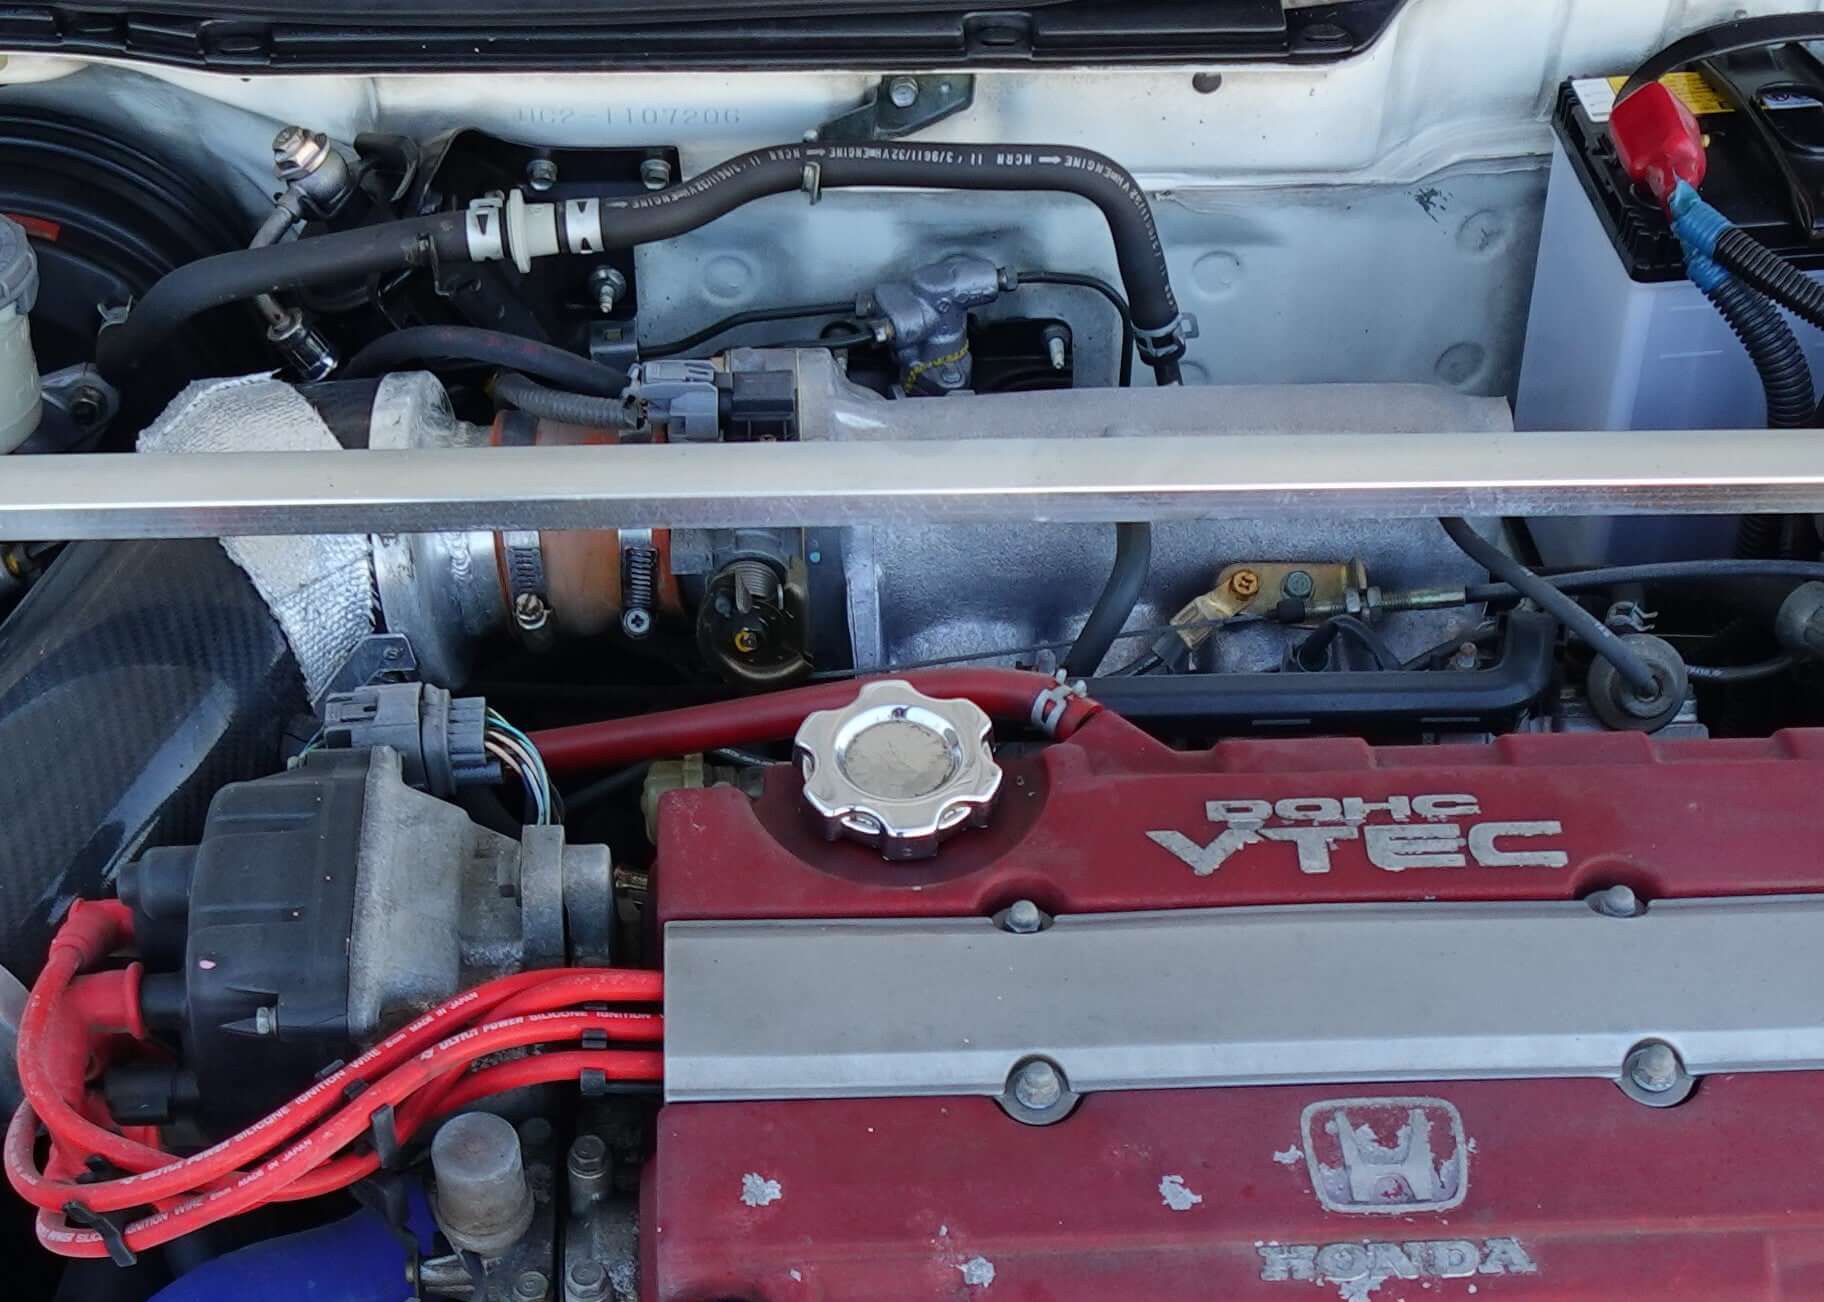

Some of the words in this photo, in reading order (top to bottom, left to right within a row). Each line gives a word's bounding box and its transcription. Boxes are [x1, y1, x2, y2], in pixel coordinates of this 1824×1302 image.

[1144, 820, 1569, 876] VTEC
[295, 1069, 346, 1105] IGNITION
[350, 1048, 382, 1069] WIRE
[449, 991, 479, 1010] JAPAN
[439, 1027, 480, 1051] ULTRA
[482, 1015, 525, 1034] POWER
[174, 1199, 205, 1216] WIRE
[1255, 1237, 1538, 1283] HONDA
